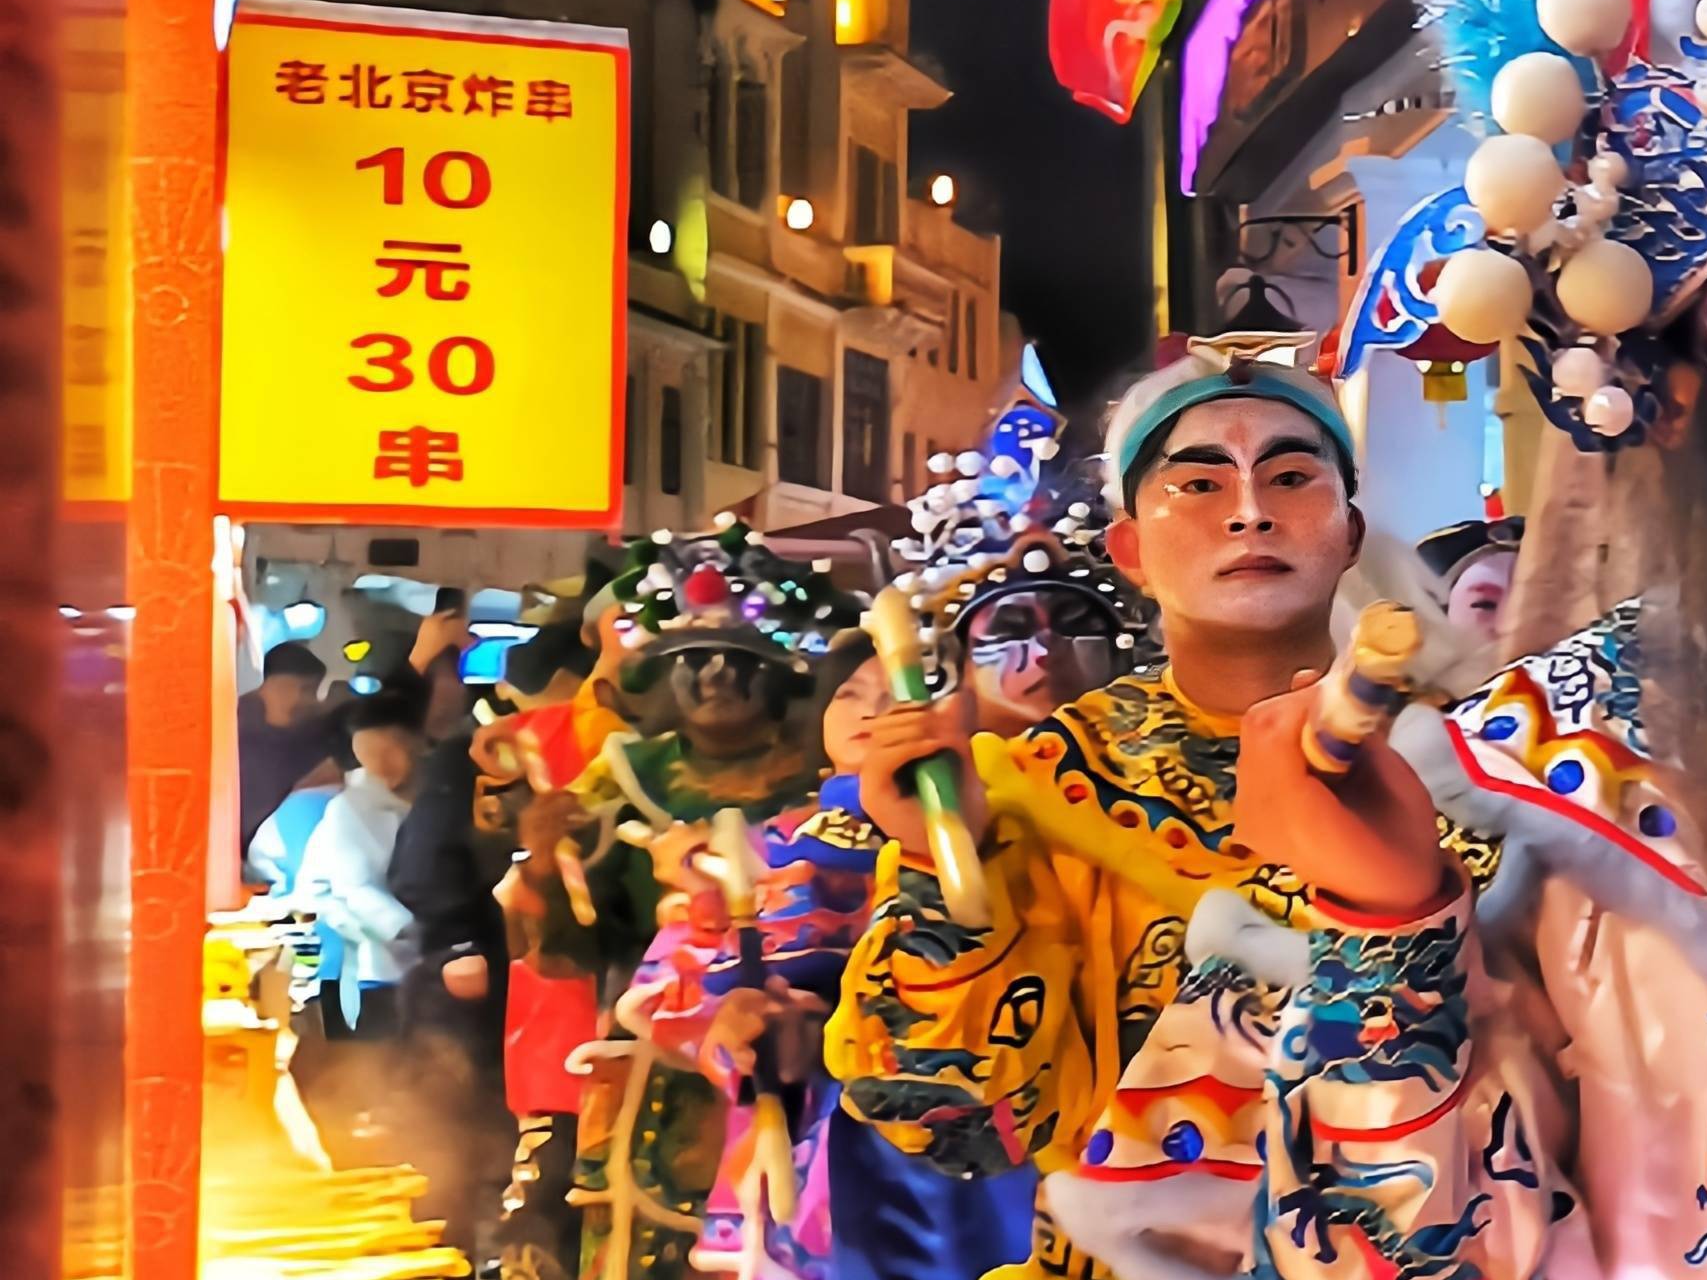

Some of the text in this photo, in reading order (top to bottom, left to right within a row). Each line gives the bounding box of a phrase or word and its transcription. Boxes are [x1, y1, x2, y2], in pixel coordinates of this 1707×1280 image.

[274, 59, 574, 123] 老北京炸串
[355, 146, 492, 210] 10
[374, 239, 471, 301] 元
[346, 332, 496, 397] 30
[373, 424, 464, 488] 串
